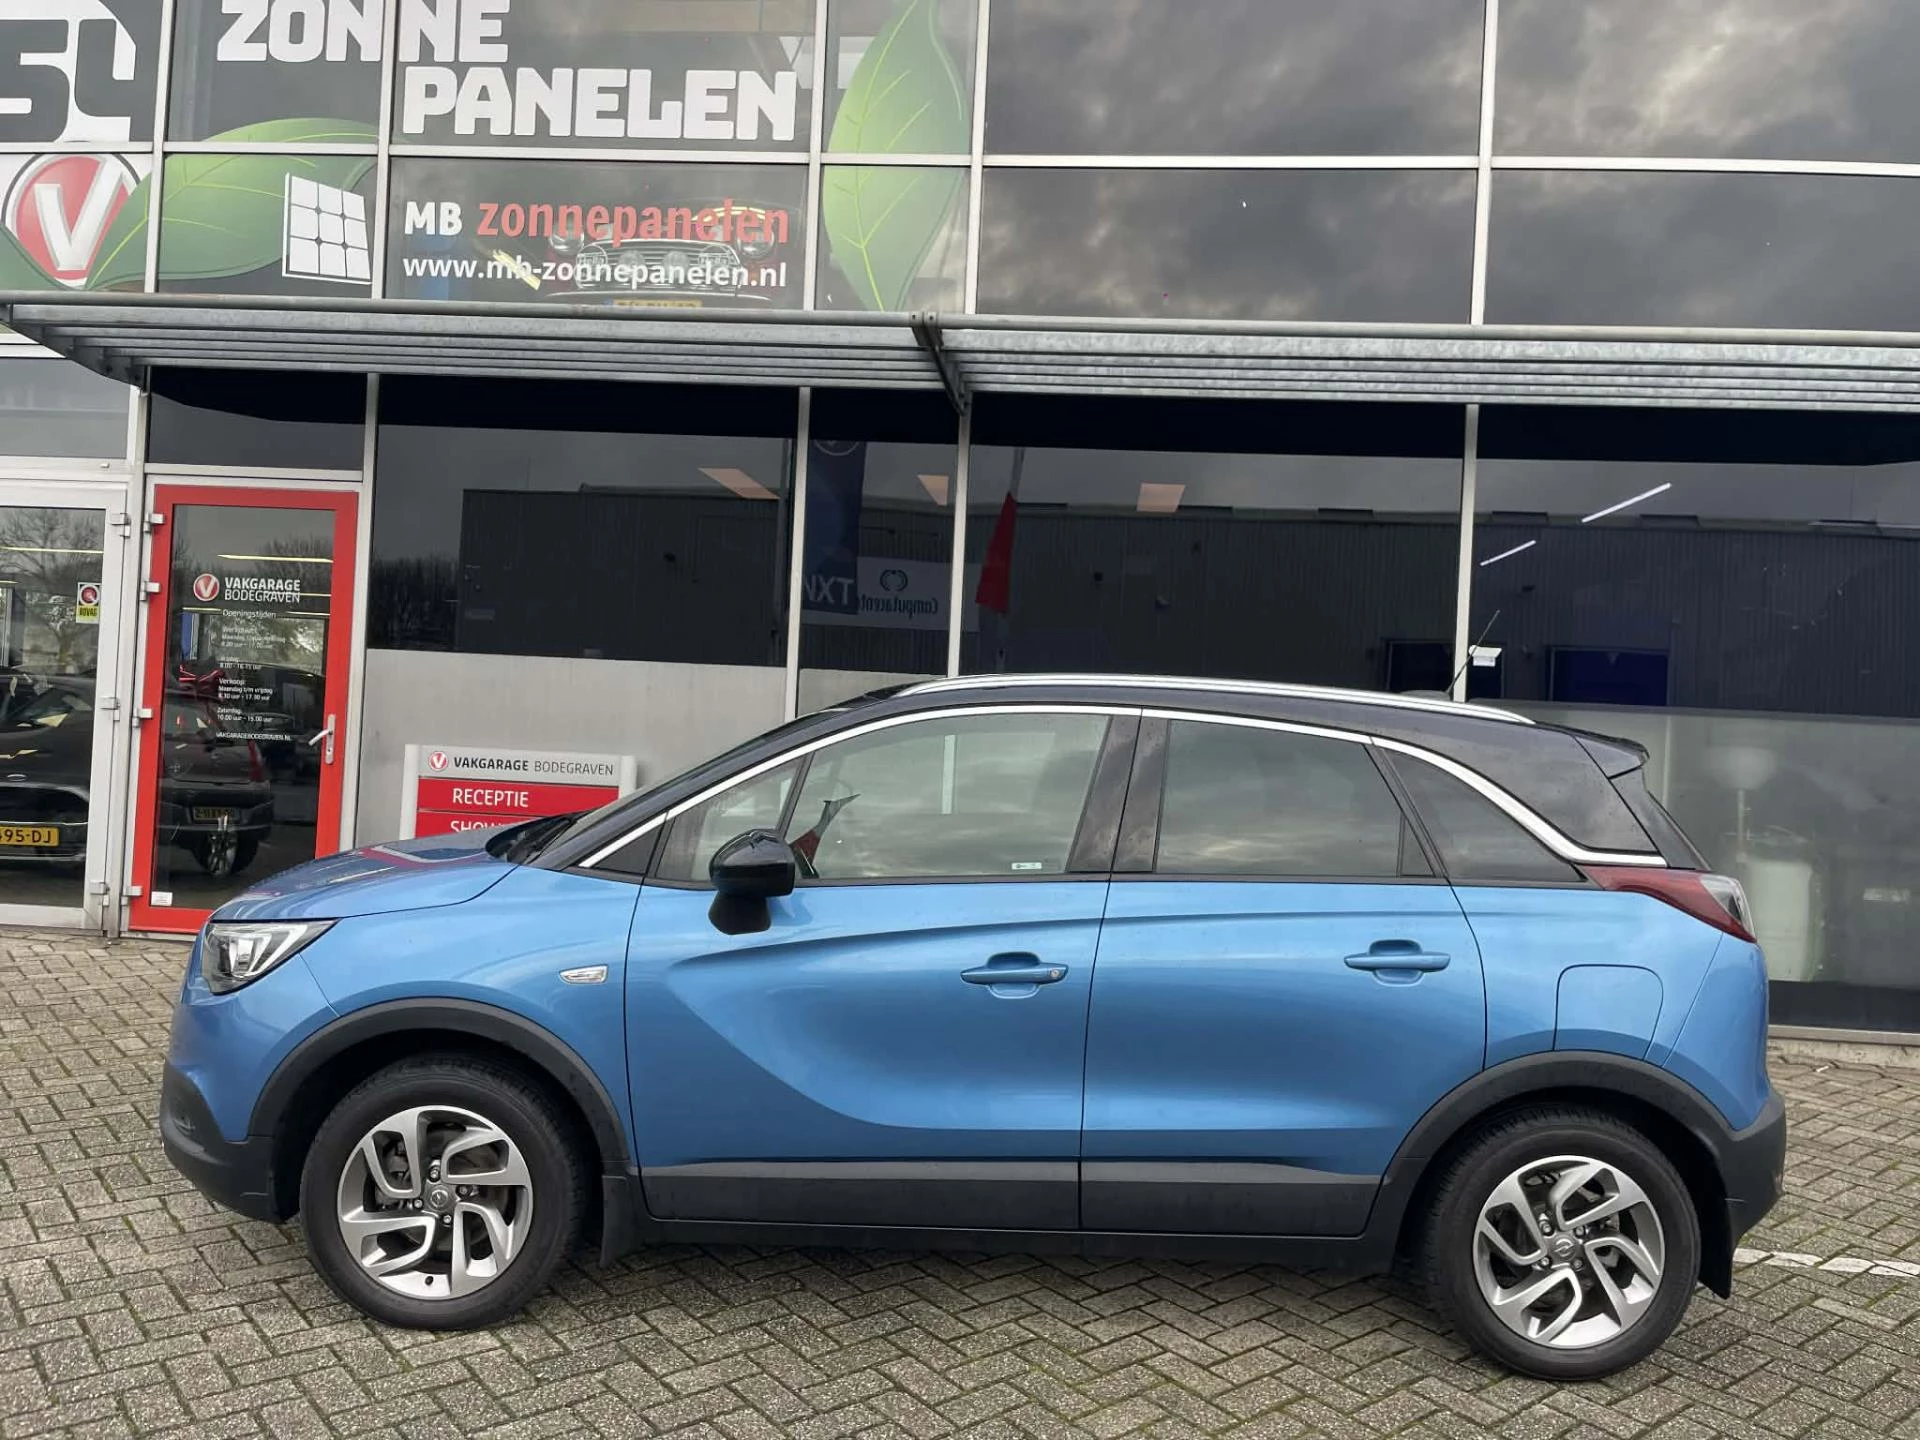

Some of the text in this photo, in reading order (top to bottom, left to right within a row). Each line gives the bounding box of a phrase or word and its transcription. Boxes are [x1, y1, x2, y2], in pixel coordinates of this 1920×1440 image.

[217, 0, 508, 63] ZONNE
[402, 66, 796, 141] PANELEN
[404, 198, 790, 249] MB zonnepanelen
[403, 254, 787, 290] www.mb-zonnepanelen.nl
[224, 577, 301, 591] VAKGARAGE
[224, 589, 300, 603] BODEGRAVEN
[454, 757, 529, 772] VAKGARAGE
[534, 760, 614, 776] BODEGRAVEN
[452, 788, 529, 808] RECEPTIE
